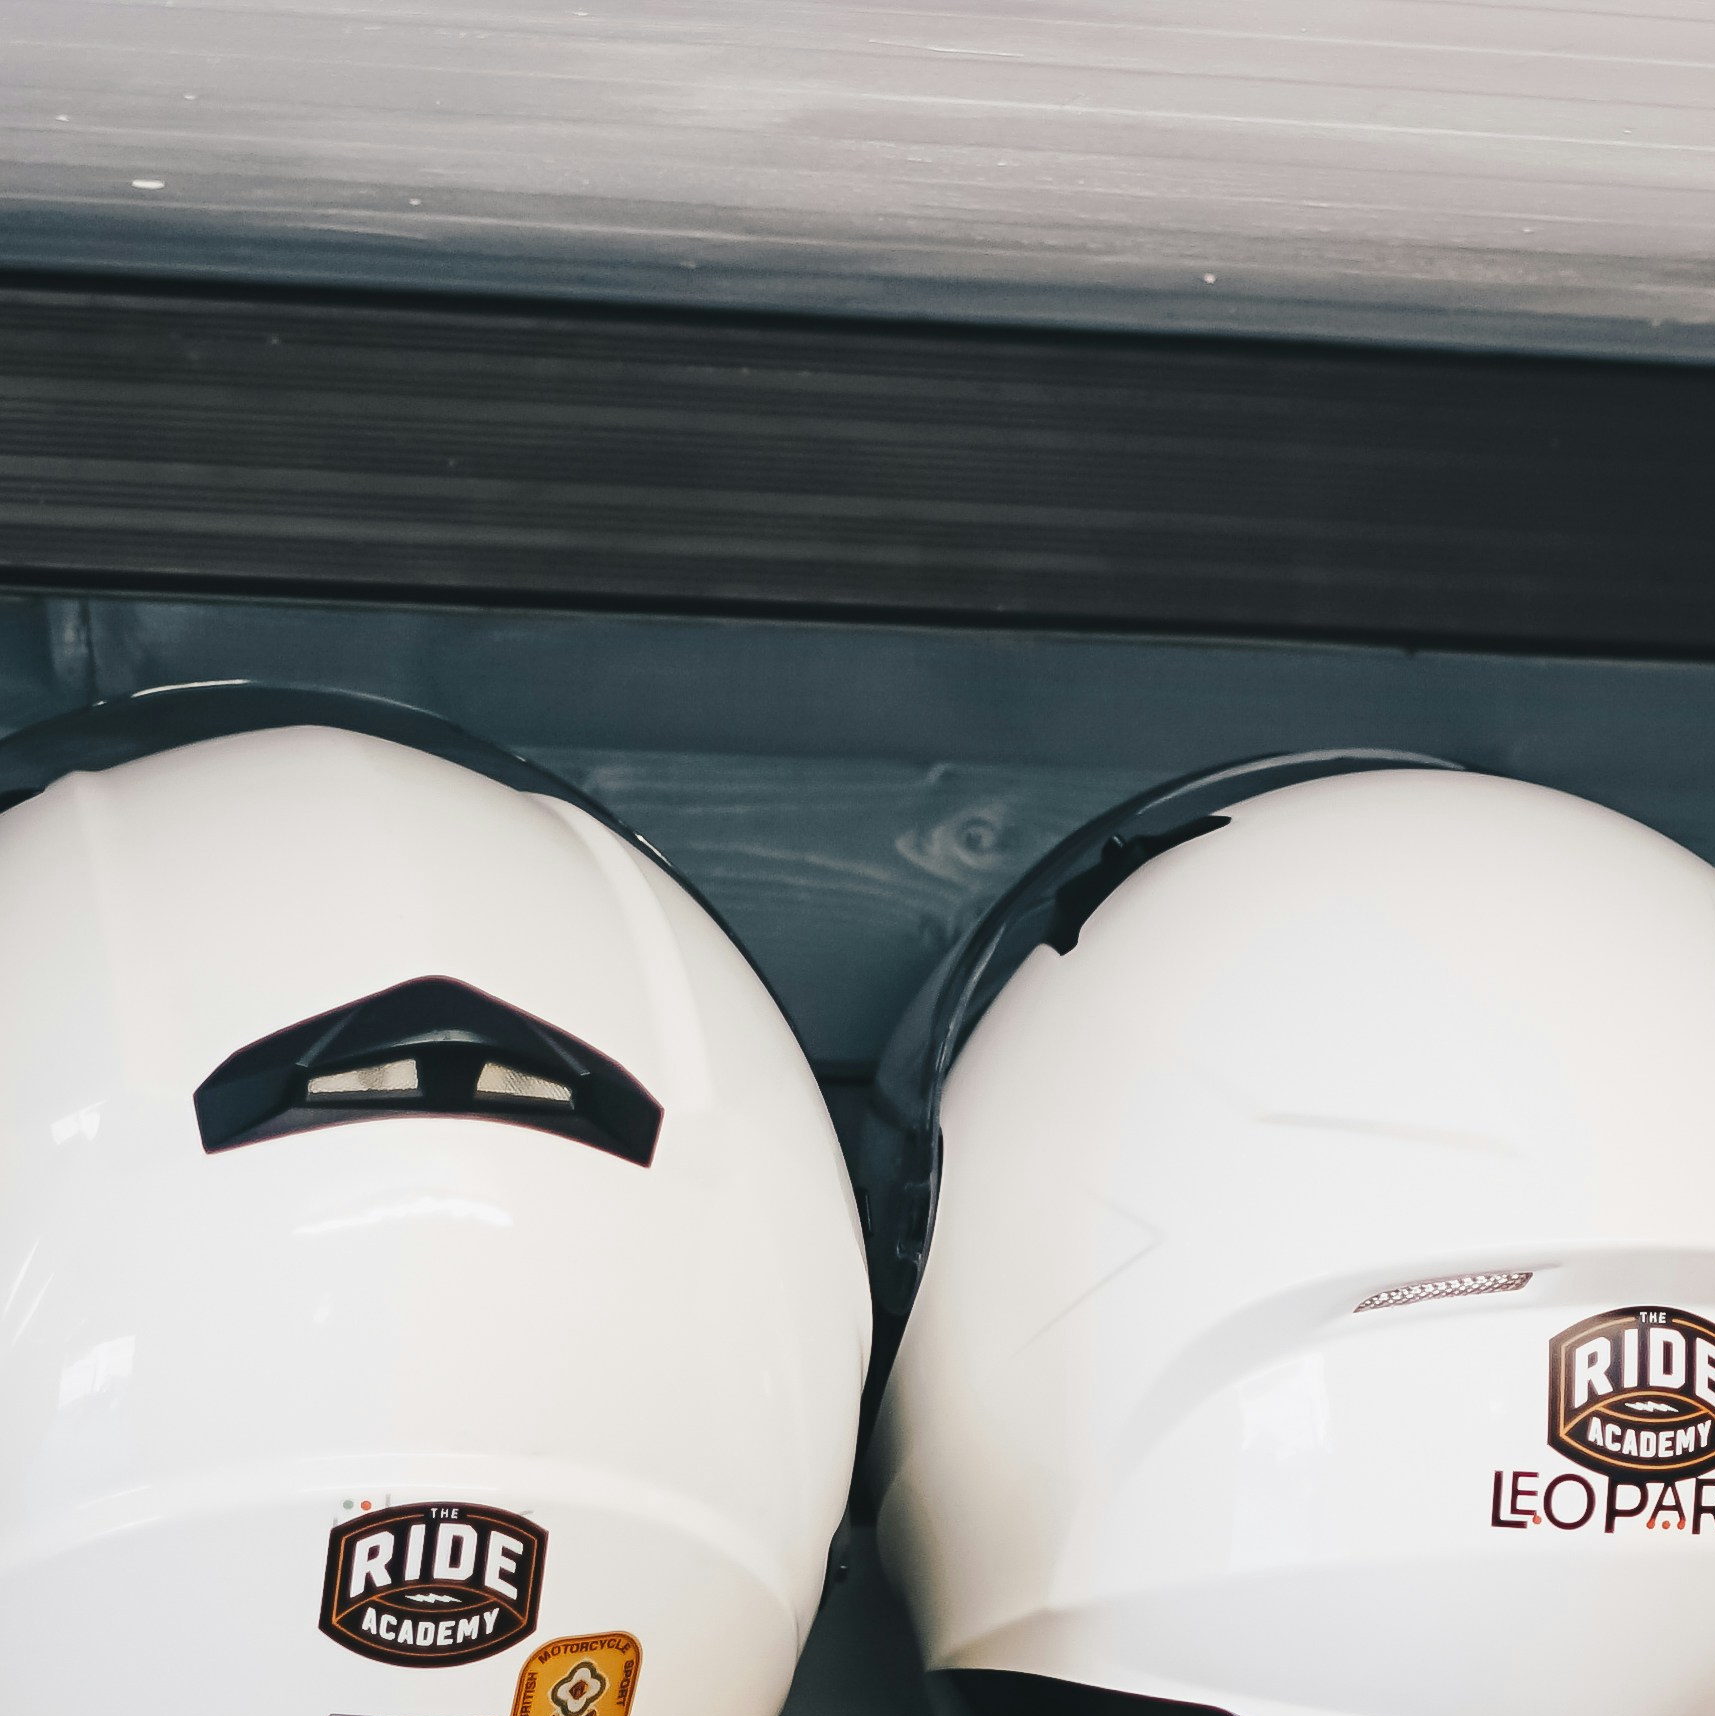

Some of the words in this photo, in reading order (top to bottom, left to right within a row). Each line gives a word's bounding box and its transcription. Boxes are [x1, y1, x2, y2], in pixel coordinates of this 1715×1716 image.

[1640, 1311, 1666, 1323] THE
[1587, 1416, 1712, 1458] ACADEMY
[431, 1507, 459, 1519] THE
[350, 1523, 524, 1600] RIDE
[362, 1607, 499, 1646] ACADEMY
[538, 1638, 631, 1664] MOTORCYCLE
[616, 1660, 634, 1706] SPORT
